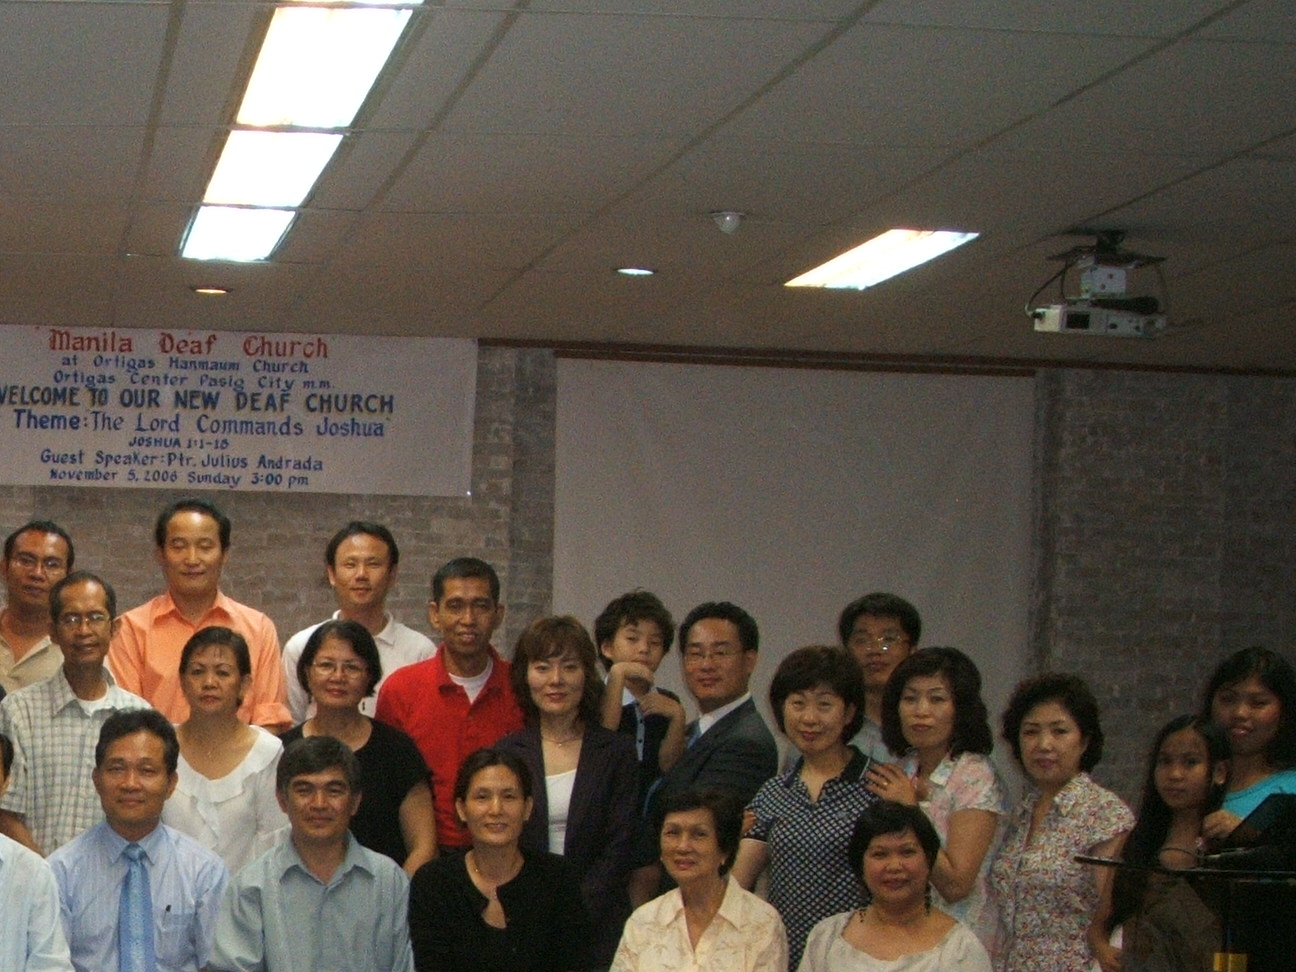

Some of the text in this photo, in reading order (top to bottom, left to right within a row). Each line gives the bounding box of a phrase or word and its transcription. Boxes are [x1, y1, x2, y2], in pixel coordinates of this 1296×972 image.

[48, 328, 328, 358] Manila Deaf Church
[61, 354, 309, 373] at Ortigas Hanmaum Church
[53, 369, 116, 387] Ortigas
[129, 372, 188, 386] Center
[199, 374, 245, 391] Pasig
[258, 375, 295, 392] City
[89, 386, 109, 407] TO
[119, 387, 161, 409] OUR
[174, 389, 220, 411] NEW
[235, 391, 291, 412] DEAF
[305, 393, 395, 414] CHURCH
[135, 412, 180, 433] Lord
[196, 414, 304, 437] Commands
[316, 416, 386, 438] Joshua
[128, 436, 181, 448] JOSHUA
[40, 448, 84, 465] Guest
[201, 453, 248, 469] Julius
[257, 454, 324, 472] Andrada
[49, 468, 118, 481] November
[187, 471, 242, 488] Sunday
[288, 475, 309, 488] pm
